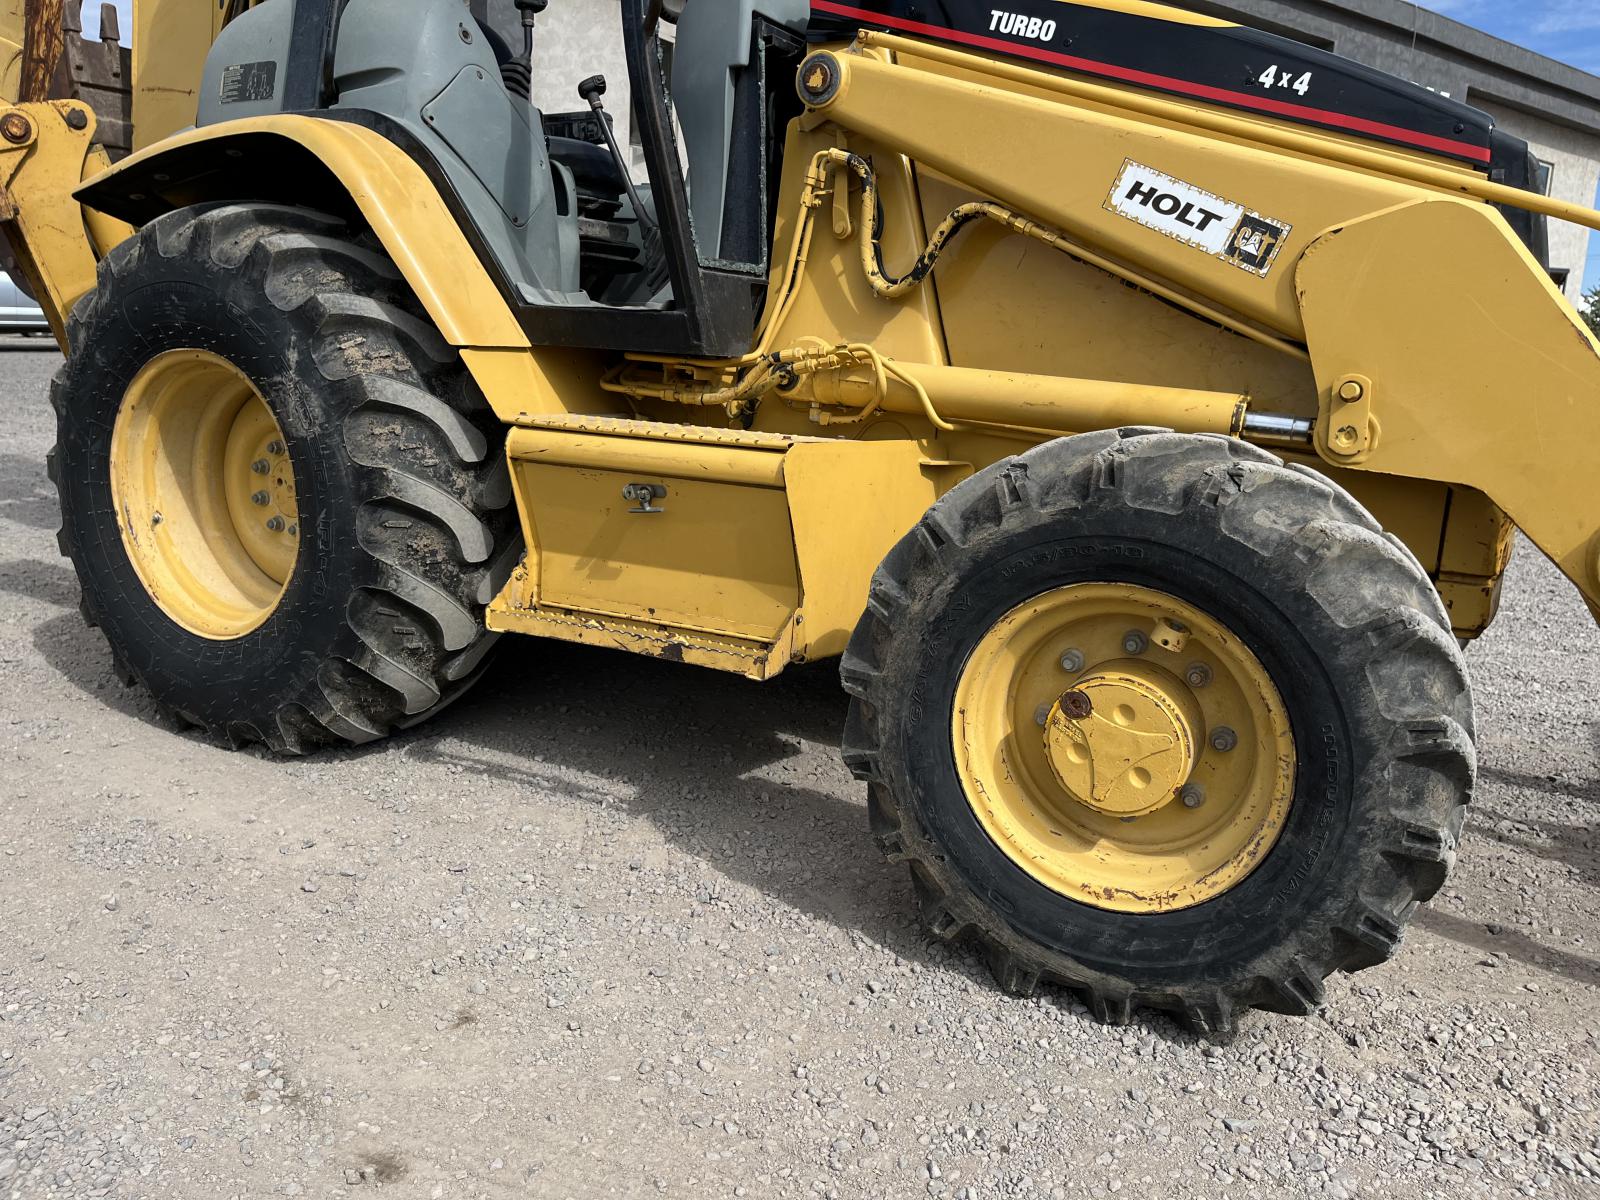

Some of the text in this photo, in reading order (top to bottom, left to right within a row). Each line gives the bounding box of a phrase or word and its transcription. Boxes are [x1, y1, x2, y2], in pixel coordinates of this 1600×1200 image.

[989, 10, 1057, 42] TURBO
[1258, 64, 1313, 96] 4x4
[1125, 180, 1276, 260] HOLT CAT
[908, 591, 972, 725] GALAXY
[1275, 723, 1339, 904] INDUSTRIAL
